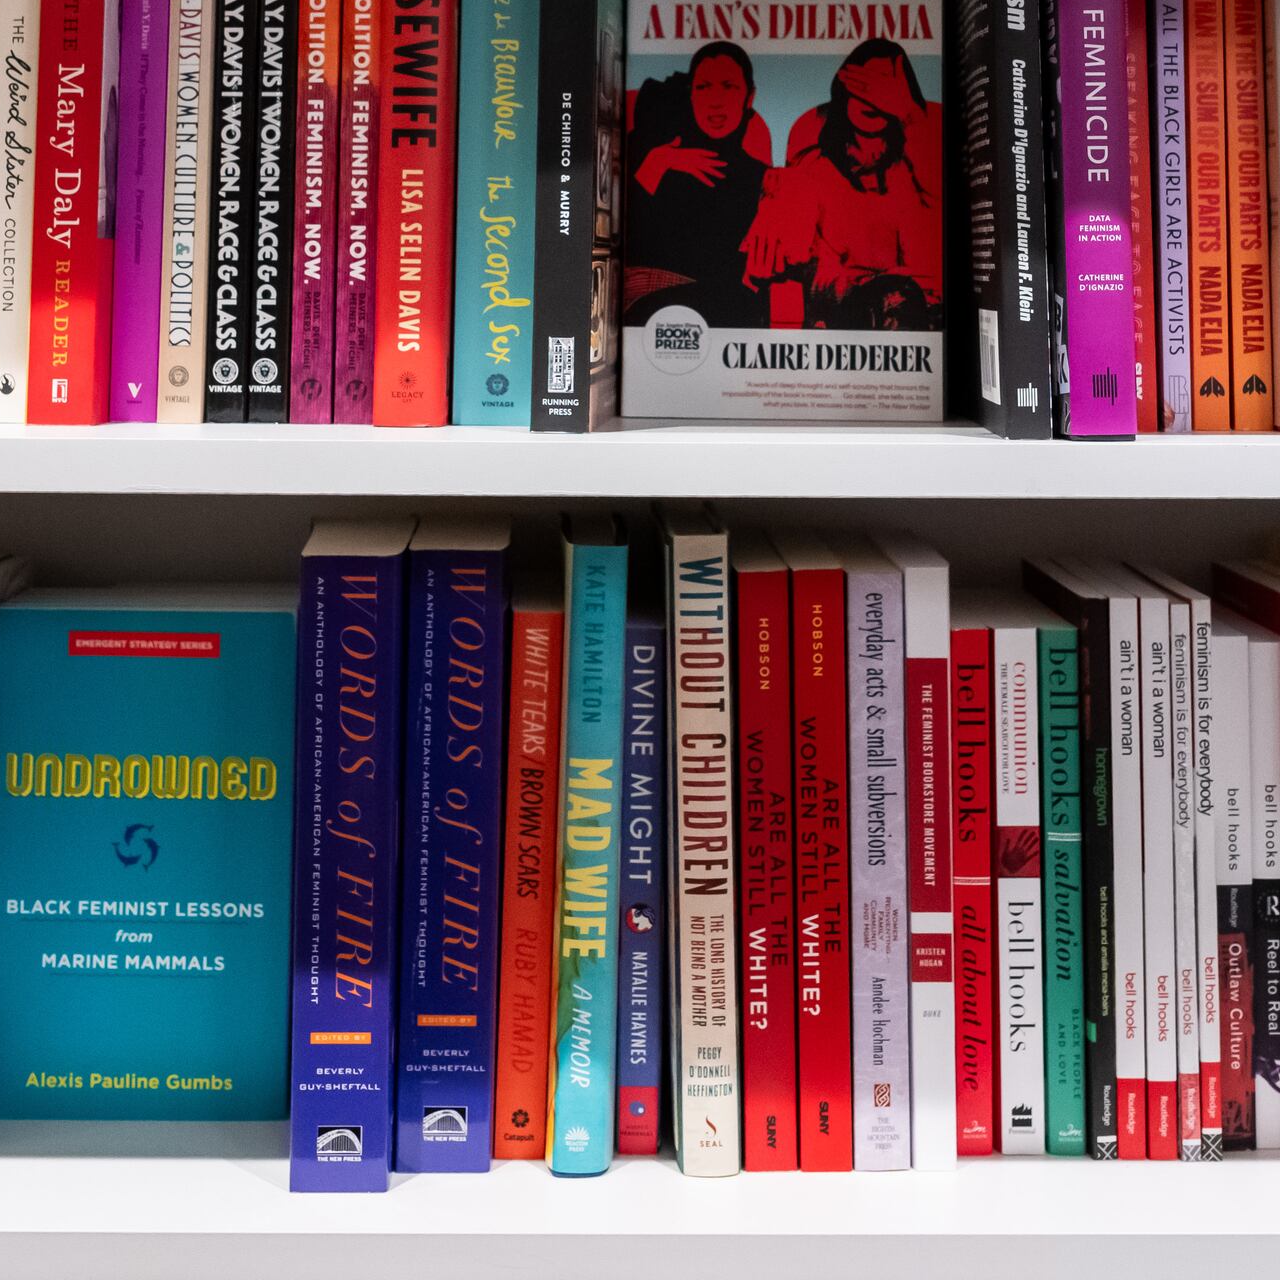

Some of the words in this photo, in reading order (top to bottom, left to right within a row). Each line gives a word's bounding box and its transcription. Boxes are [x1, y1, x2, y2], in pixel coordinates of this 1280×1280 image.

[643, 3, 665, 40] A
[674, 1, 761, 40] FAN'S
[769, 3, 933, 41] DILEMMA
[50, 64, 85, 157] Mary
[561, 92, 573, 108] DE
[560, 112, 572, 167] CHIRICO
[400, 168, 423, 215] LISA
[560, 174, 571, 183] &
[46, 168, 82, 248] Daly
[558, 190, 571, 236] MURRY
[399, 221, 422, 282] SELIN
[52, 259, 71, 367] READER
[397, 289, 421, 353] DAVIS
[722, 342, 810, 372] CLAIRE
[815, 343, 933, 374] DEDERER
[630, 644, 655, 756] DIVINE
[920, 683, 934, 704] THE
[921, 707, 934, 756] FEMINIST
[5, 753, 278, 800] UNDROWNED
[566, 757, 613, 850] MAD
[922, 761, 935, 825] BOOKSTORE
[627, 773, 653, 885] MIGHT
[922, 826, 936, 888] MOVEMENT
[6, 899, 71, 916] BLACK
[77, 900, 169, 917] FEMINIST
[175, 901, 264, 919] LESSONS
[562, 864, 608, 960] WIFE
[1007, 900, 1036, 953] bell
[41, 954, 119, 970] MARINE
[125, 955, 226, 972] MAMMALS
[115, 928, 153, 945] from
[630, 951, 648, 1006] NATALIE
[1008, 965, 1036, 1053] hooks
[629, 1011, 646, 1065] HAYNES
[25, 1071, 83, 1088] Alexis
[89, 1072, 159, 1089] Pauline
[165, 1073, 233, 1091] Gumbs
